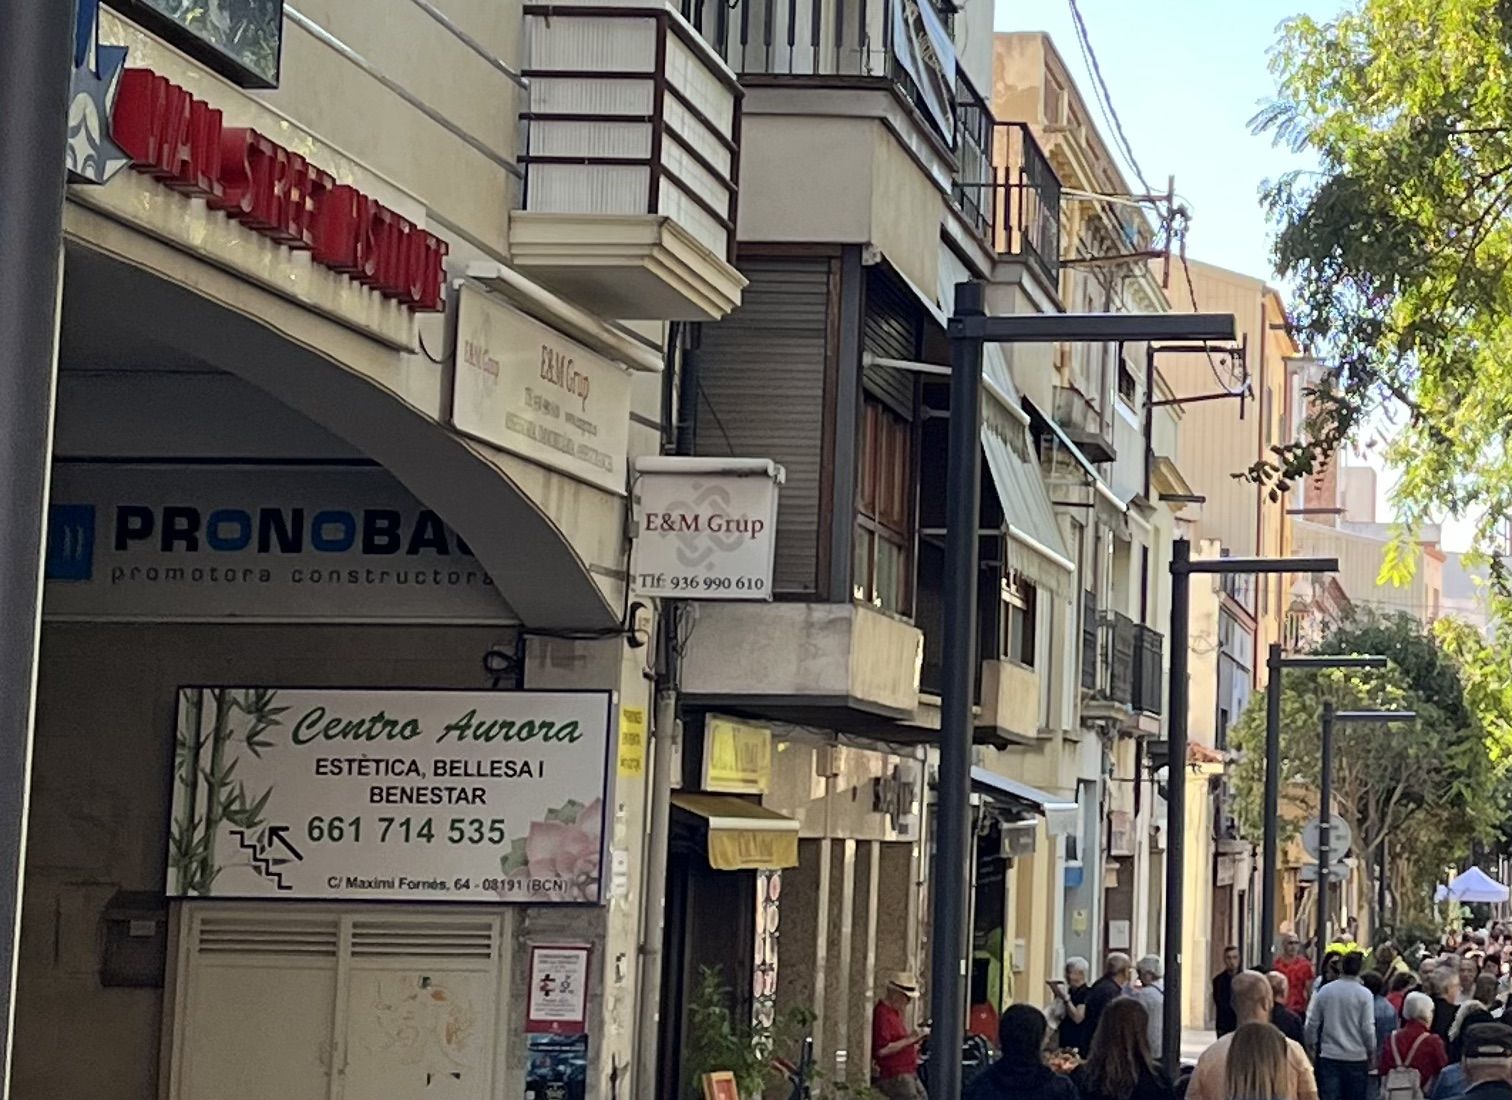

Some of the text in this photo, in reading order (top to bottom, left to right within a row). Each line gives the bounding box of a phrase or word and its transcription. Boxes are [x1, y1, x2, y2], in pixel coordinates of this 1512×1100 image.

[645, 513, 764, 539] E&M Grup
[111, 564, 272, 585] promotora
[670, 576, 699, 590] 936
[703, 576, 731, 590] 990
[736, 576, 764, 590] 610
[291, 706, 584, 746] Centro Aurora
[315, 753, 544, 779] ESTÈTICA, BELLESA I
[369, 787, 487, 806] BENESTAR
[307, 816, 506, 845] 661 714 535
[327, 876, 342, 889] C/
[453, 878, 471, 890] 64
[526, 878, 569, 893] (BCN)
